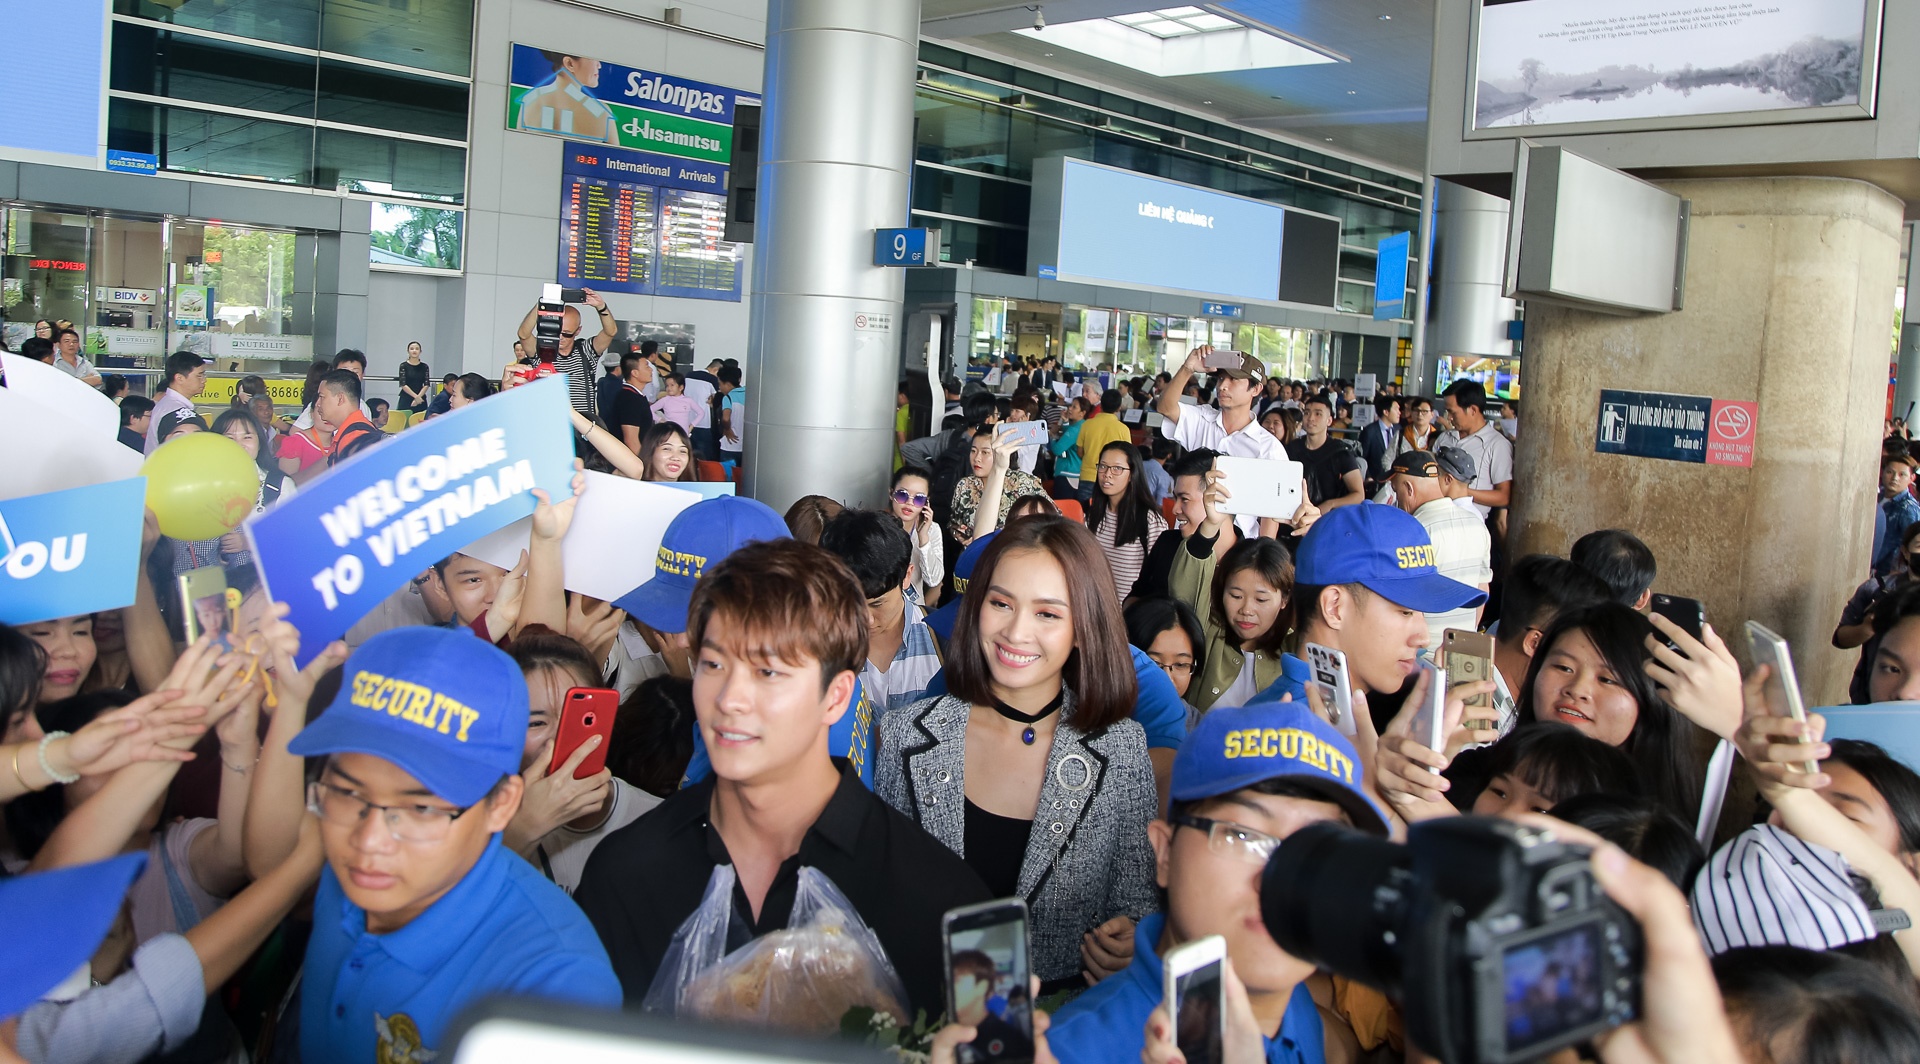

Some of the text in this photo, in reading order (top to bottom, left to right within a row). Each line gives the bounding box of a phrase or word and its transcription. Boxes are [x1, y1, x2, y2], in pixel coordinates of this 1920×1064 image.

[624, 72, 724, 114] Salonpas
[622, 118, 720, 152] Hisamitsu
[606, 158, 716, 184] International Arrivals
[894, 234, 906, 260] 9
[115, 292, 138, 300] BIDV
[1629, 400, 1705, 432] VUI LÒNG BỎ RÁC VÀO THÙNG
[1674, 435, 1682, 448] Xin
[1722, 453, 1743, 462] SMOKING
[319, 428, 508, 548] WELCOME
[312, 460, 536, 610] TO VIETNAM
[6, 532, 87, 579] OU
[351, 670, 480, 742] SECURITY
[1224, 727, 1353, 784] SECURITY
